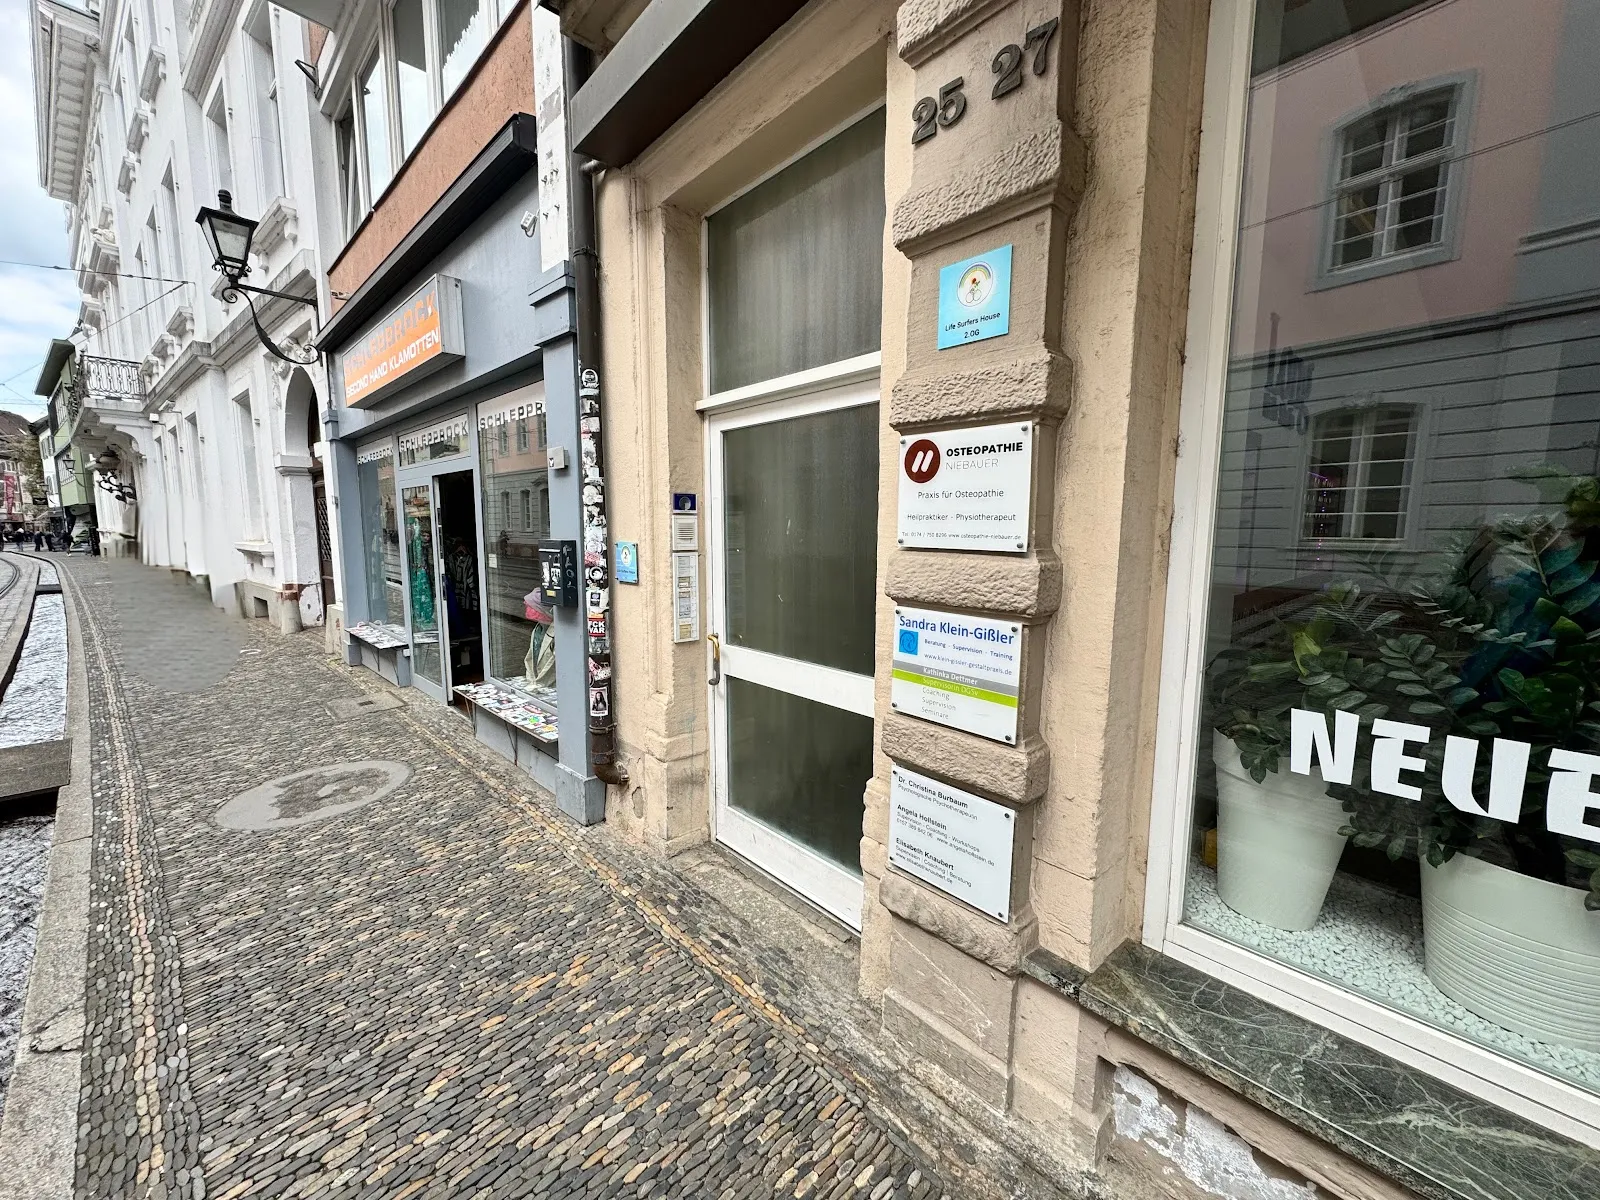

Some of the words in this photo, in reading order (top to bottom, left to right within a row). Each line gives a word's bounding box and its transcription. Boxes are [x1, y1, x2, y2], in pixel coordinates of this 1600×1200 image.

[912, 76, 967, 144] 25
[991, 17, 1058, 100] 27
[945, 324, 956, 332] Life
[957, 317, 979, 329] Surfers
[980, 312, 1001, 323] House
[964, 329, 980, 339] 2.OG
[346, 376, 369, 397] SECOND
[369, 363, 388, 383] HAND
[389, 328, 440, 372] KLAMOTTEN
[400, 419, 468, 452] SCHLEPPROCK
[946, 442, 1023, 457] OSTEOPATHIE
[945, 458, 998, 471] NIEBAUER
[917, 491, 940, 499] Praxis
[941, 490, 952, 499] für
[954, 489, 1004, 499] Osteopathie
[907, 513, 948, 522] Heilpraktiker
[955, 513, 1016, 522] Physiotherapeut
[899, 615, 936, 632] Sandra
[939, 622, 1015, 645] Klein-Gißler
[924, 638, 946, 649] Beratung
[952, 644, 983, 655] Supervision
[990, 650, 1013, 661] Training
[923, 666, 950, 680] Kathinka
[950, 673, 978, 686] Dettmer
[923, 676, 960, 693] Supervisorin
[921, 696, 956, 711] Supervision
[922, 686, 950, 701] Coaching
[921, 706, 949, 720] Seminare
[1290, 707, 1600, 842] NEUE
[898, 775, 907, 785] Dr.
[908, 780, 937, 797] Christina
[937, 791, 968, 809] Burbaum
[897, 804, 918, 818] Angela
[919, 812, 947, 831] Hollstein
[897, 811, 922, 826] Supervision
[925, 824, 948, 840] Coaching
[896, 837, 923, 856] Elisabeth
[924, 851, 954, 871] Knaubert
[924, 859, 946, 875] Coaching
